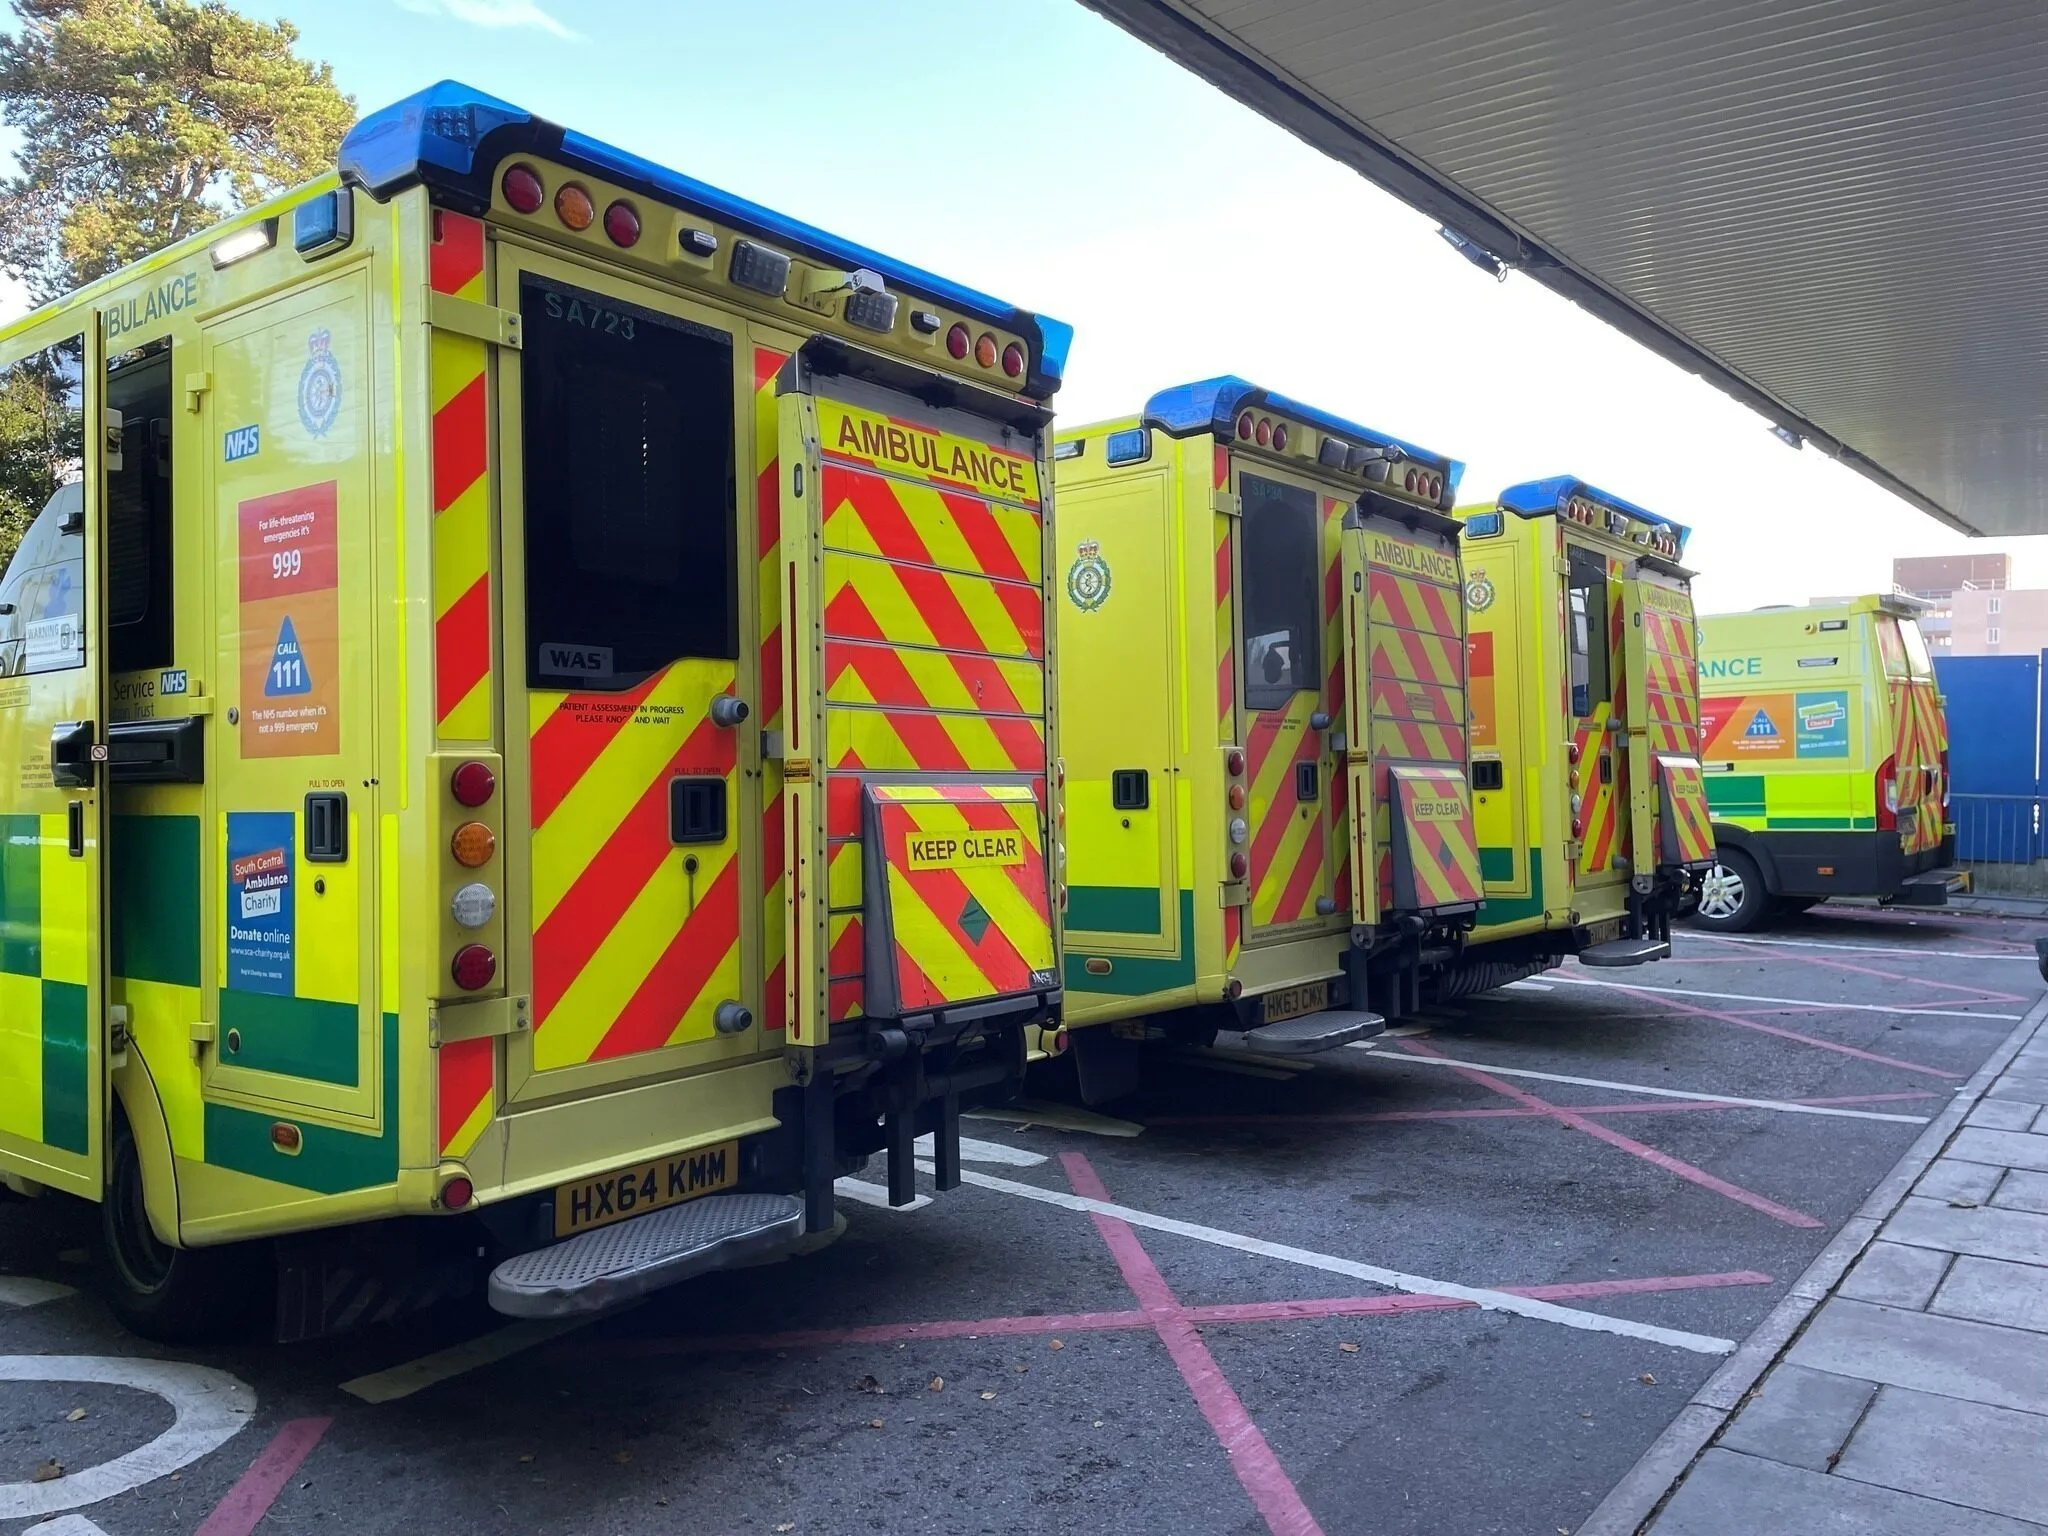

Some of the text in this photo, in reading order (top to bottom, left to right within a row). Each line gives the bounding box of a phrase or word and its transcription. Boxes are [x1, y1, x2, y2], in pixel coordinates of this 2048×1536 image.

[544, 292, 636, 341] SA723
[225, 427, 258, 458] NHS
[838, 415, 1026, 494] AMBULANCE
[259, 511, 315, 531] For life-threatening
[263, 524, 310, 543] emergencies it's
[272, 549, 301, 579] 999
[1373, 538, 1454, 579] AMBULANCE
[28, 623, 59, 640] WARNING
[277, 642, 298, 655] CALL
[549, 649, 602, 670] WAS
[273, 659, 301, 689] 111
[113, 671, 186, 701] Service NHS
[133, 702, 155, 719] Trust
[252, 705, 327, 720] The NHS number when it's
[559, 702, 685, 714] PATIENT ASSESSMENT IN PROGRESS
[258, 723, 269, 734] not
[274, 722, 285, 733] 999
[285, 721, 319, 734] emergency
[575, 714, 603, 723] PLEASE
[634, 716, 650, 724] AND
[652, 716, 671, 724] WAIT
[1751, 723, 1771, 735] 111
[308, 779, 345, 788] PULL TO OPEN
[1415, 801, 1461, 815] KEEP CLEAR
[911, 837, 1018, 861] KEEP CLEAR
[235, 852, 284, 876] South Central
[244, 873, 289, 891] Ambulance
[245, 893, 278, 912] Charity
[231, 925, 290, 944] Donate online
[230, 947, 290, 962] www.sca-charity.org.uk
[1267, 991, 1299, 1018] HK63
[571, 1148, 727, 1226] HX64 KMM
